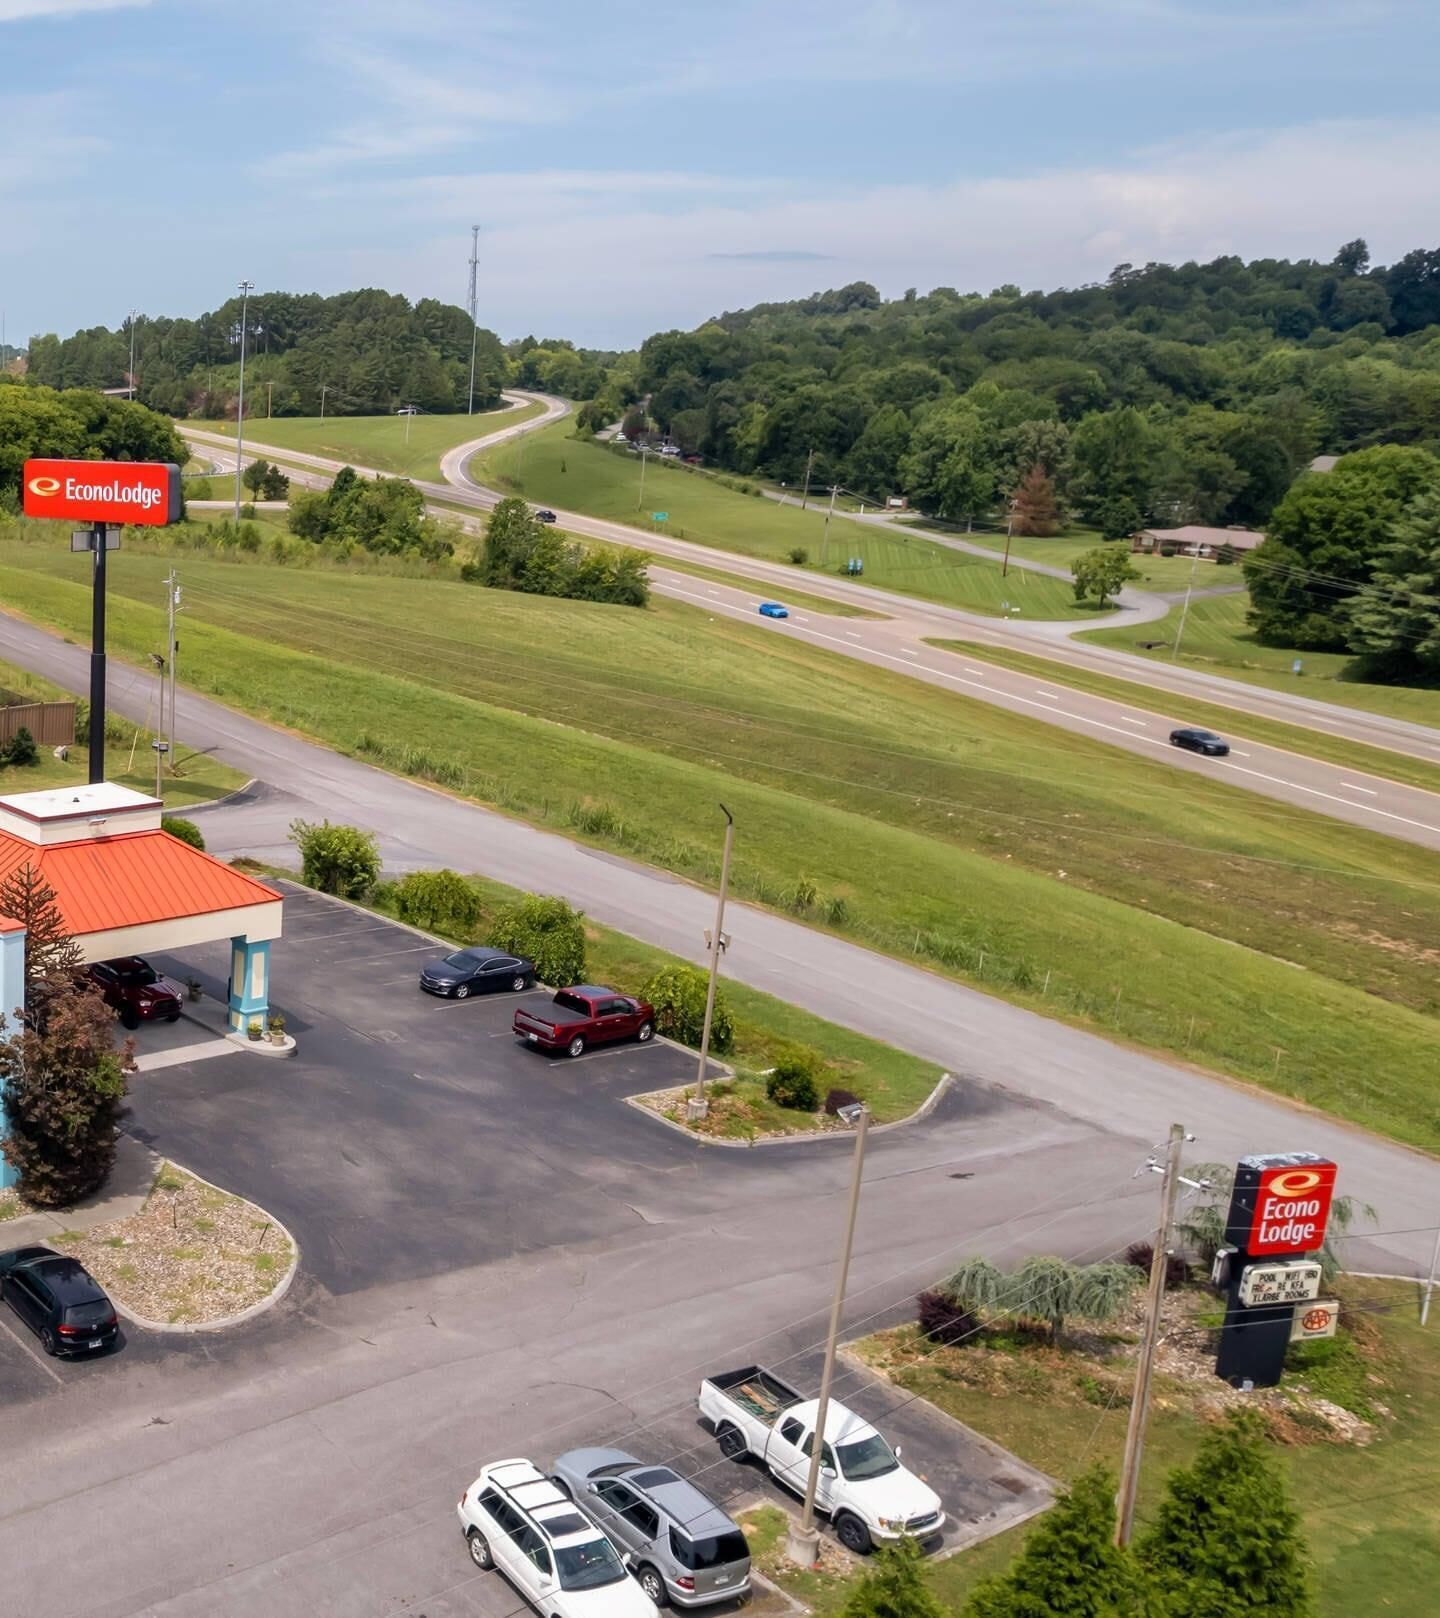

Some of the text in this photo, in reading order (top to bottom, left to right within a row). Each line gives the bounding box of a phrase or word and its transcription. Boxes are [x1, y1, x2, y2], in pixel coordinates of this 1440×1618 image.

[65, 478, 162, 509] EconoLodge
[1263, 1198, 1320, 1220] Econo
[1259, 1219, 1315, 1245] Lodge
[1259, 1273, 1277, 1282] POOL
[1284, 1271, 1301, 1281] WIFI
[1284, 1290, 1310, 1300] ROOMS
